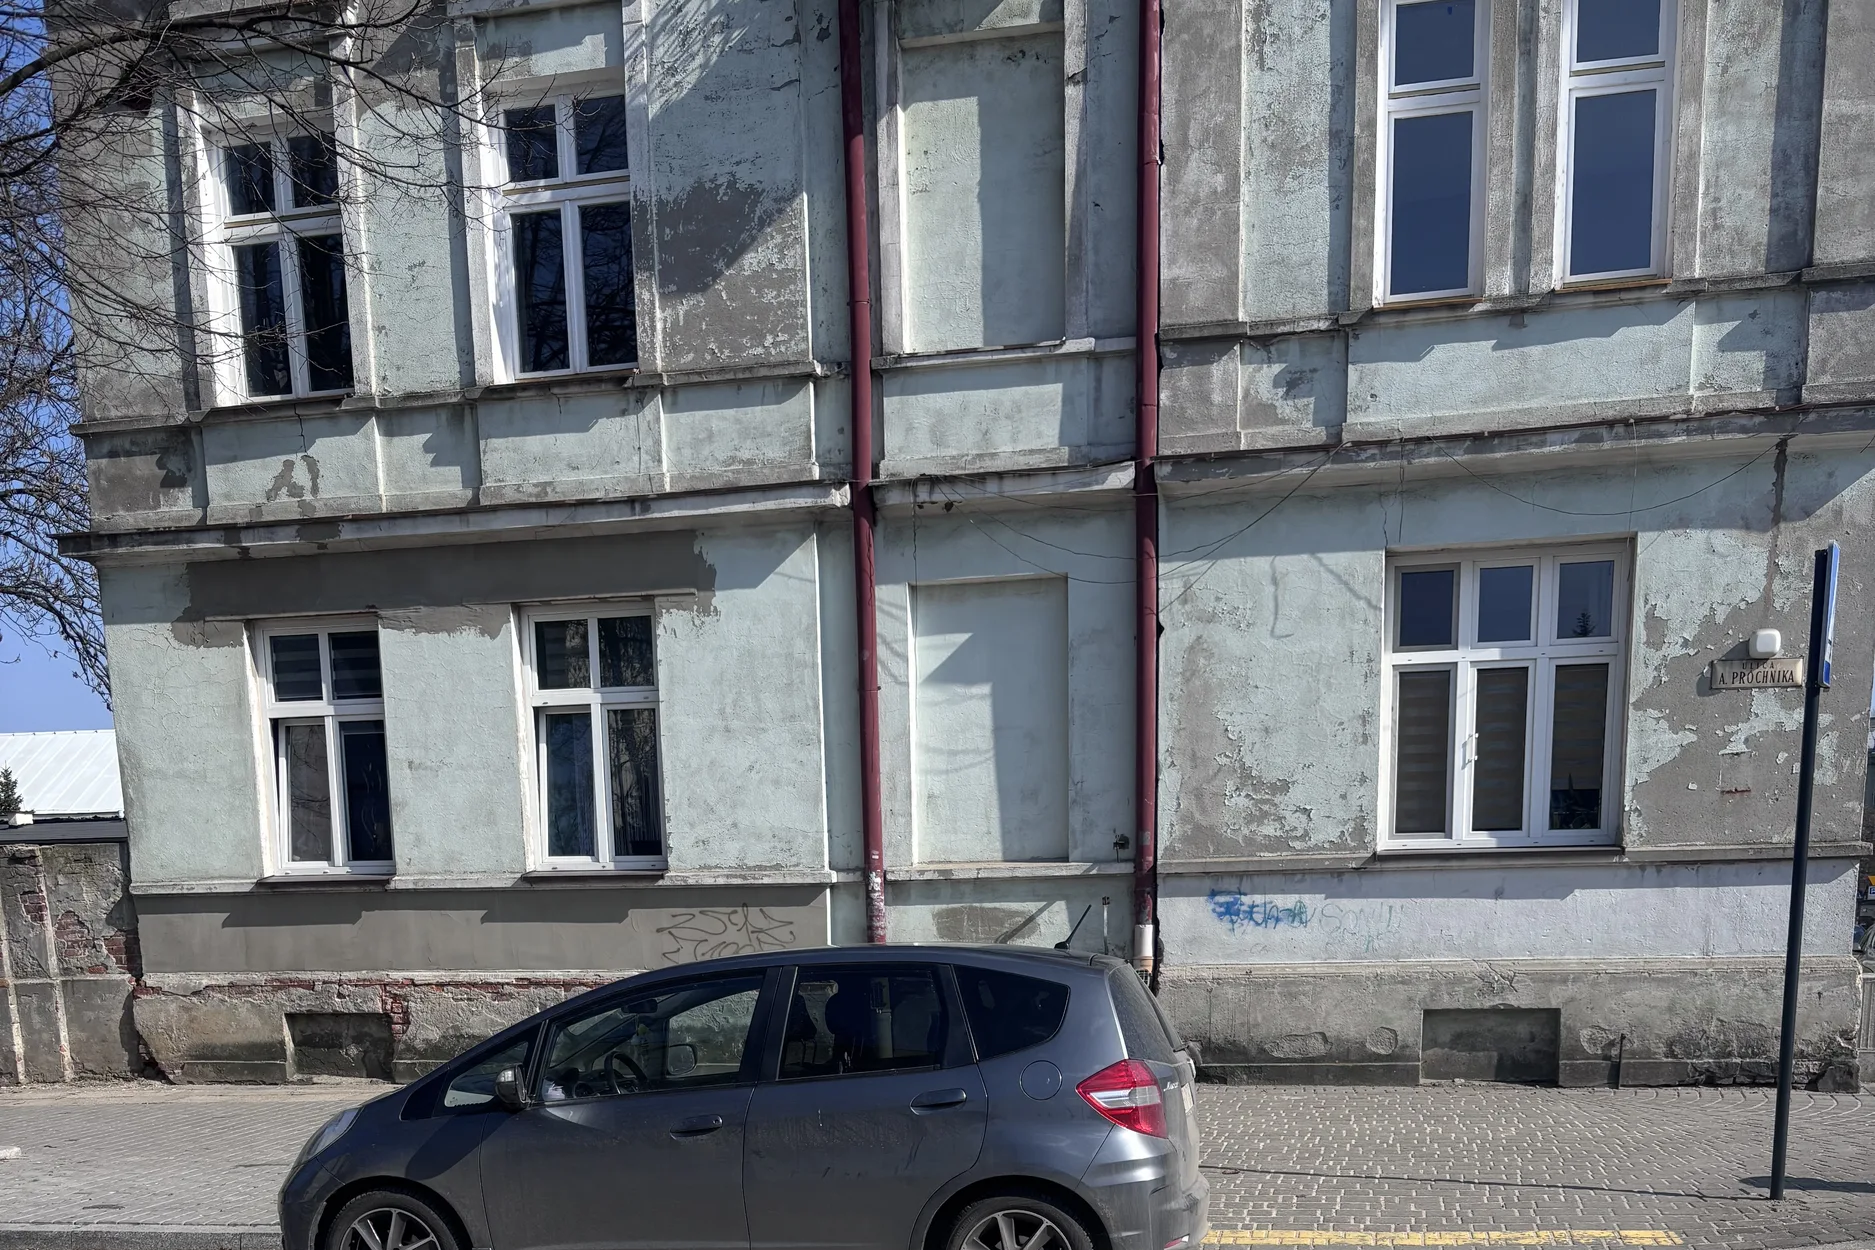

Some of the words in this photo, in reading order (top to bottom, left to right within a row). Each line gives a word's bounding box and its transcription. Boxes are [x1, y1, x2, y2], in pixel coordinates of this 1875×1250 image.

[1742, 661, 1774, 670] ULICA
[1718, 672, 1728, 685] A.
[1731, 669, 1795, 685] PRÓCHNIKA
